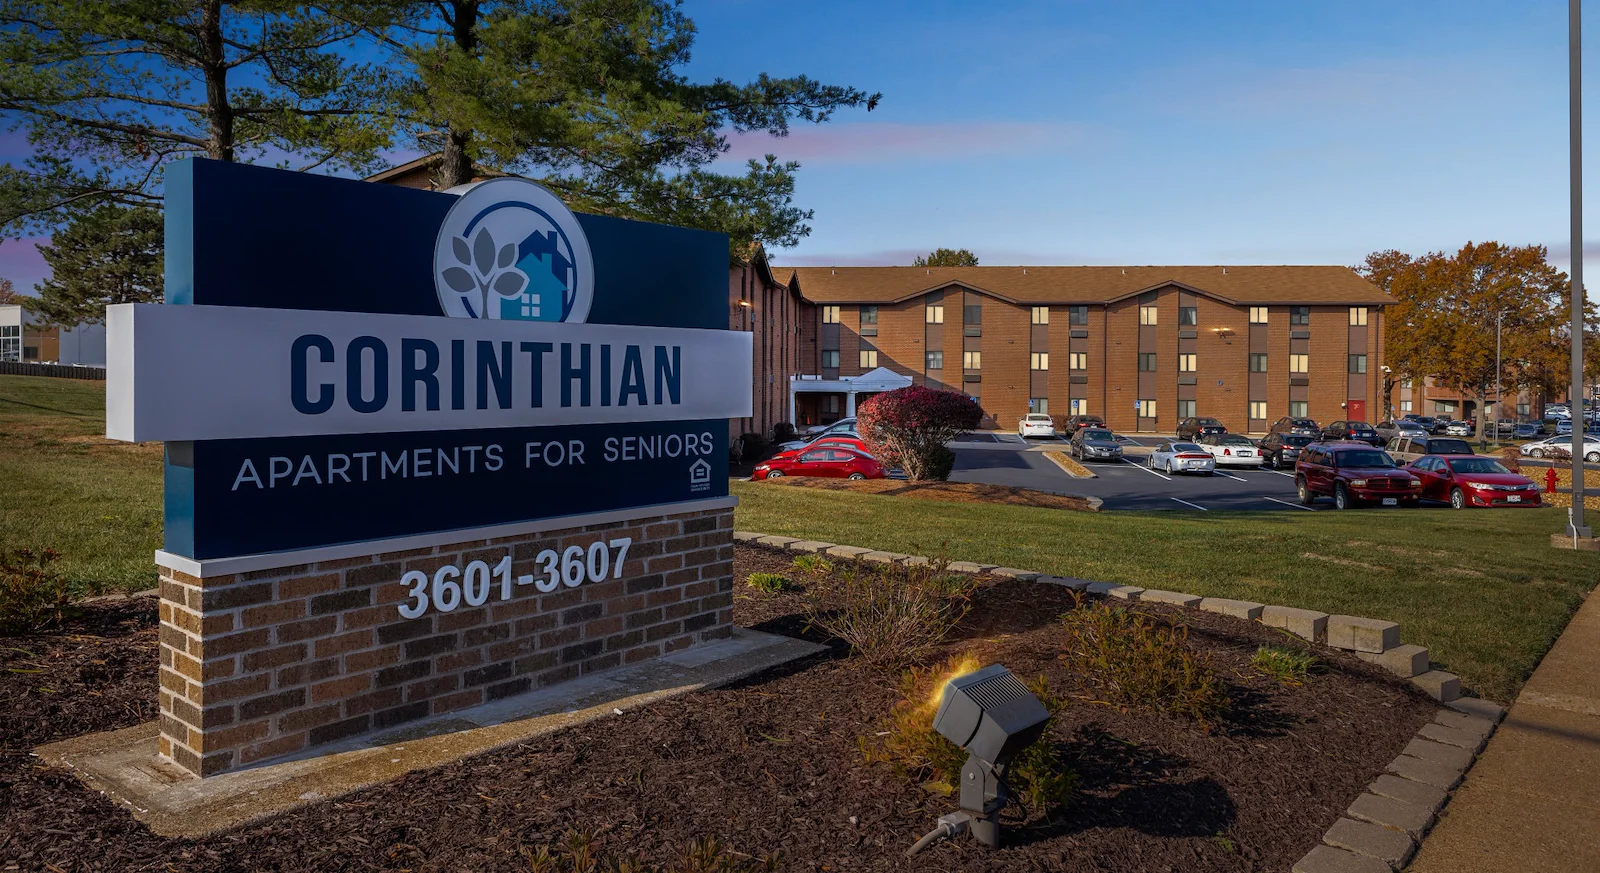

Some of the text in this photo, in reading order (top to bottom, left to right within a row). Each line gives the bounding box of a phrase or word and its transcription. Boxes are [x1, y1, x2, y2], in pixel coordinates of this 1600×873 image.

[291, 334, 681, 414] CORINTHIAN
[231, 431, 713, 491] APARTMENTS FOR SENIORS
[398, 538, 631, 619] 3601-3607
